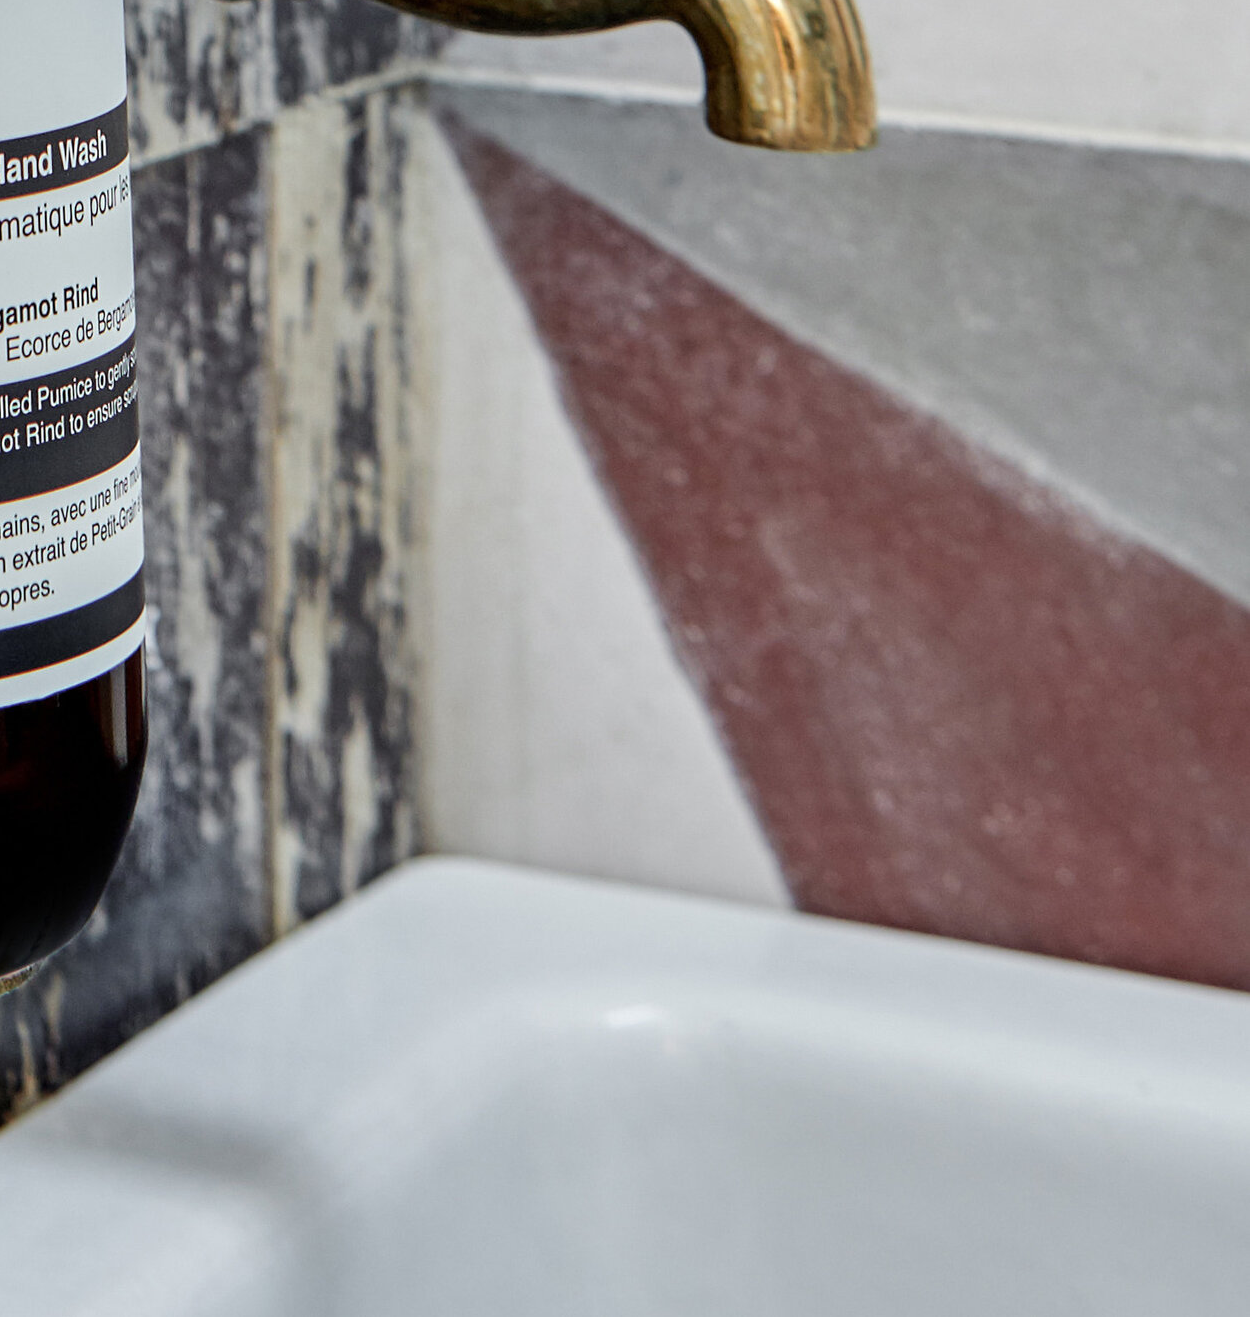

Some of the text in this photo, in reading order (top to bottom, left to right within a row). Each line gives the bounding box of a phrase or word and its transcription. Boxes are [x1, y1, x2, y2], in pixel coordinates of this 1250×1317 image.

[58, 129, 107, 171] Wash
[89, 185, 118, 227] pour
[63, 276, 99, 312] Rind
[6, 328, 71, 362] Ecorce
[75, 317, 94, 344] de
[37, 377, 93, 411] Pumice
[94, 370, 106, 391] to
[107, 352, 130, 390] gently
[26, 415, 65, 448] Rind
[68, 413, 84, 435] to
[86, 395, 123, 428] ensure
[50, 499, 87, 527] avec
[89, 488, 112, 513] une
[113, 476, 128, 501] fine
[12, 536, 66, 571] extrait
[69, 530, 88, 555] de
